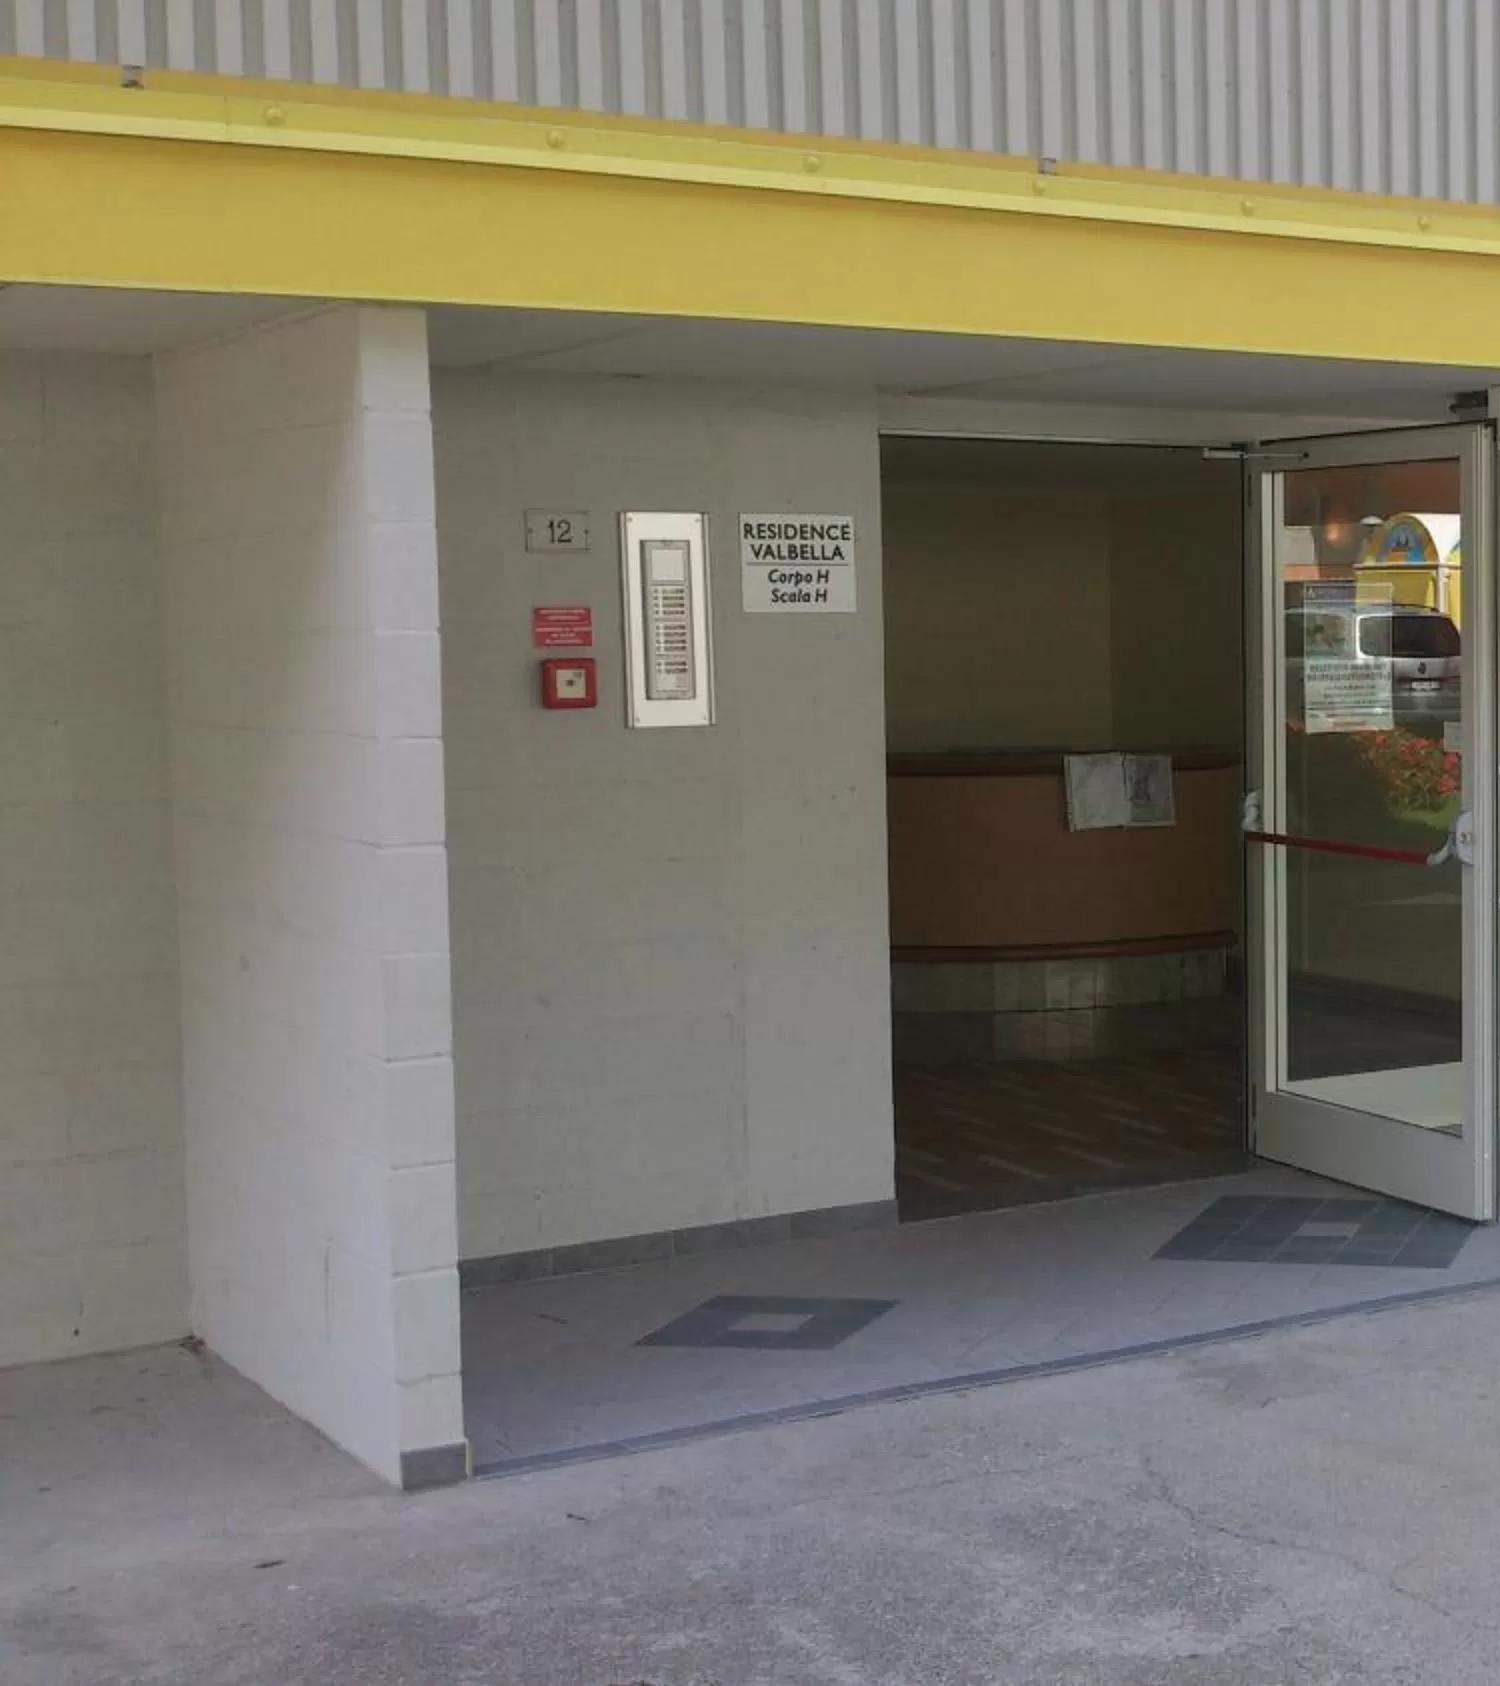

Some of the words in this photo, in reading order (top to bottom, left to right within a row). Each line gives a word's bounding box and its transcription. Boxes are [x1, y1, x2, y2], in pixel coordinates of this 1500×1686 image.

[548, 520, 572, 544] 12
[743, 523, 852, 542] RESIDENCE
[750, 544, 846, 562] VALBELLA
[767, 568, 813, 586] Corpo
[815, 569, 830, 584] H
[770, 588, 811, 604] Scala
[812, 589, 828, 603] H
